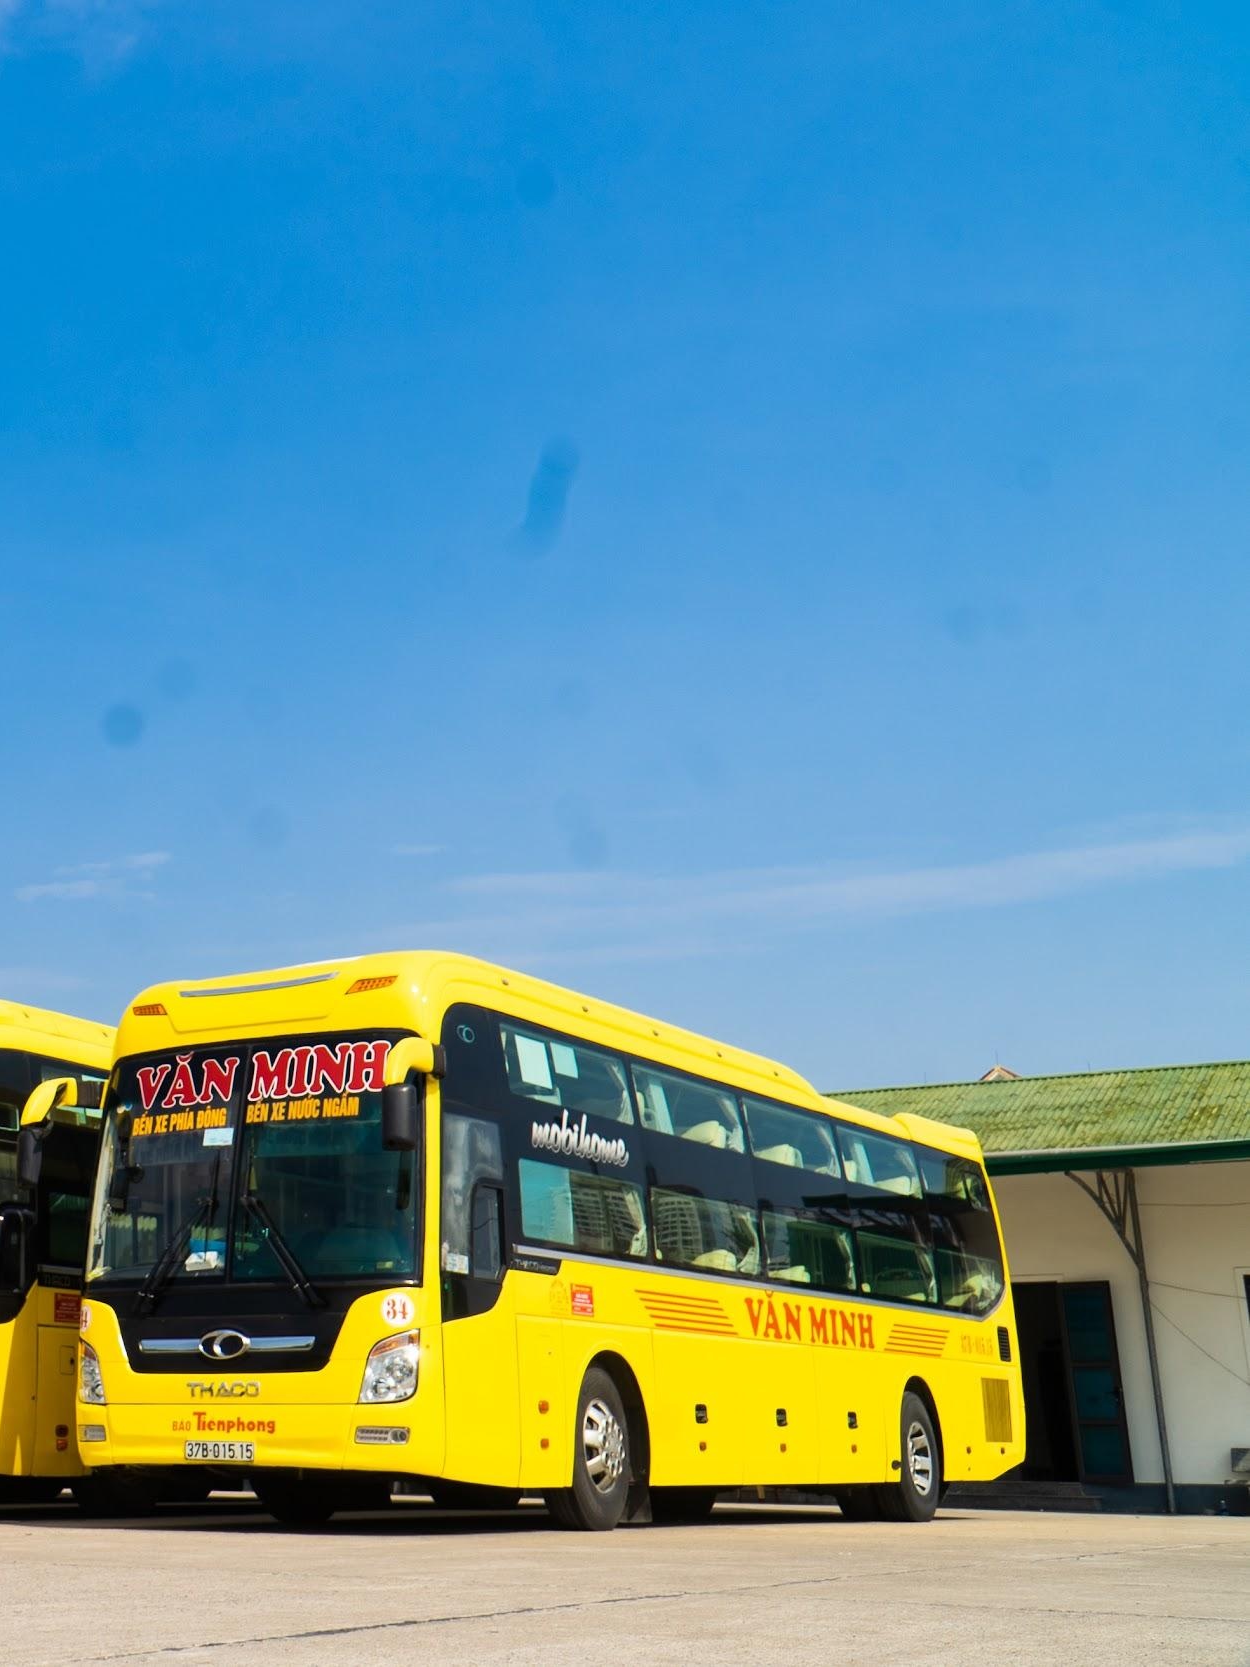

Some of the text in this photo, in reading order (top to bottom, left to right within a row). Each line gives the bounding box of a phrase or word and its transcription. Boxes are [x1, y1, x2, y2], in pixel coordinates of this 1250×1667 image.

[136, 1040, 391, 1110] VĂN MINH
[132, 1109, 153, 1137] BẾN
[154, 1115, 169, 1134] XE
[246, 1096, 268, 1124] BẾN
[271, 1102, 286, 1121] XE
[532, 1108, 630, 1168] mobihome
[387, 1299, 408, 1320] 34
[744, 1289, 875, 1349] VĂN MINH
[187, 1382, 260, 1398] THACO
